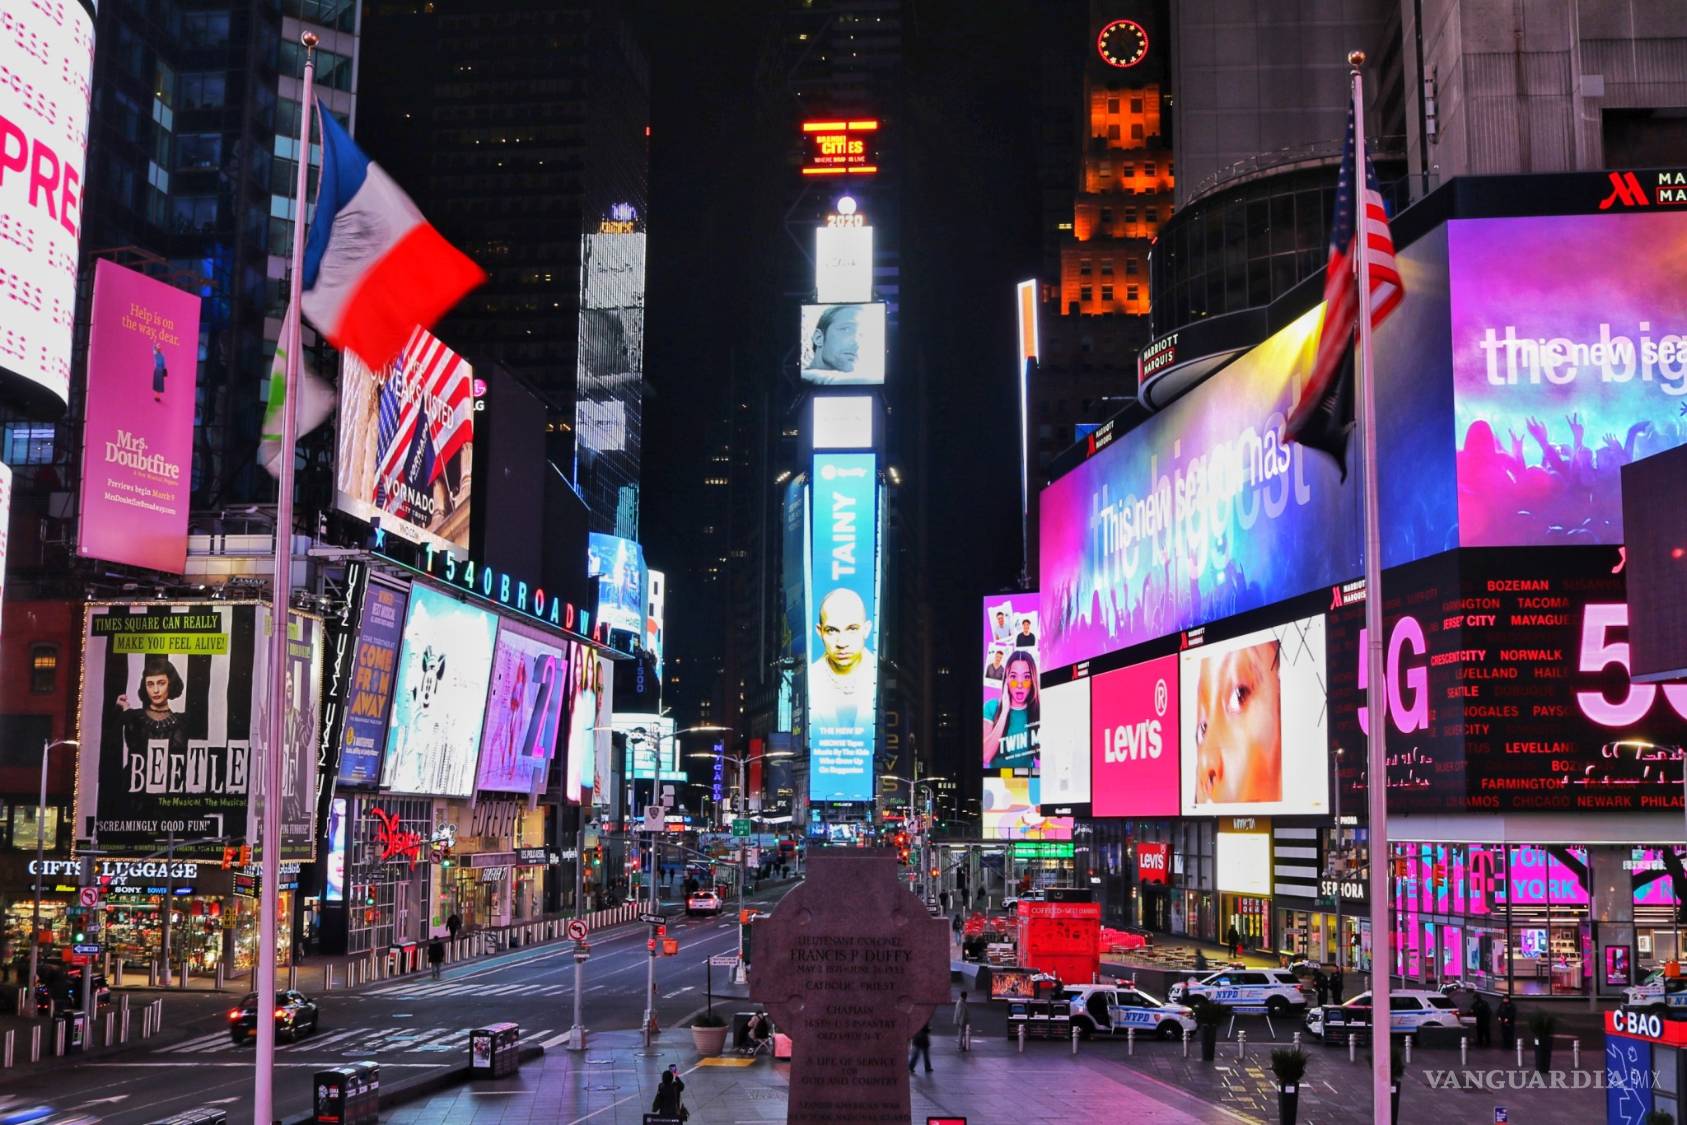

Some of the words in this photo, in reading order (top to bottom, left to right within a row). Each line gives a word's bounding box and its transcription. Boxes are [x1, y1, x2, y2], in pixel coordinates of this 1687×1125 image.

[822, 141, 864, 154] CITIES
[827, 215, 863, 227] 2020
[122, 315, 137, 331] the
[130, 303, 152, 325] Help
[154, 312, 161, 325] is
[162, 319, 174, 330] on
[1143, 333, 1178, 361] MARRIOTT
[1144, 351, 1173, 375] MARQUIS
[424, 389, 454, 429] LISTED
[117, 429, 148, 451] Mrs.
[105, 441, 179, 479] Doubtfire
[384, 474, 435, 515] VORNADO
[832, 492, 857, 581] TAINY
[1487, 580, 1549, 592] BOZEMAN
[1517, 598, 1569, 609] TACOMA
[95, 617, 121, 631] TIMES
[124, 616, 160, 632] SQUARE
[162, 615, 181, 630] CAN
[183, 615, 218, 629] REALLY
[1466, 615, 1496, 626] CITY
[117, 636, 145, 649] MAKE
[148, 636, 165, 649] YOU
[169, 636, 191, 650] FEEL
[195, 636, 225, 650] ALIVE!
[360, 642, 393, 671] COME
[1461, 650, 1486, 662] CITY
[1500, 650, 1563, 661] NORWALK
[355, 665, 390, 695] FROM
[636, 658, 644, 692] 1500
[350, 690, 386, 718] AWAY
[522, 654, 568, 760] 21
[998, 731, 1028, 755] TWIN
[128, 740, 248, 794] BEETLE
[1481, 778, 1566, 790] FARMINGTON
[1577, 796, 1631, 808] NEWARK
[161, 820, 185, 832] GOOD
[102, 861, 198, 879] LUGGAGE
[114, 886, 142, 894] SONY
[1514, 879, 1577, 899] YORK
[790, 949, 847, 961] FRANCIS
[865, 949, 912, 962] DUFFY
[805, 980, 851, 991] CATHOLIC
[1216, 990, 1239, 999] NYPD
[1124, 1012, 1150, 1022] NYPD
[1627, 1011, 1660, 1037] BAO
